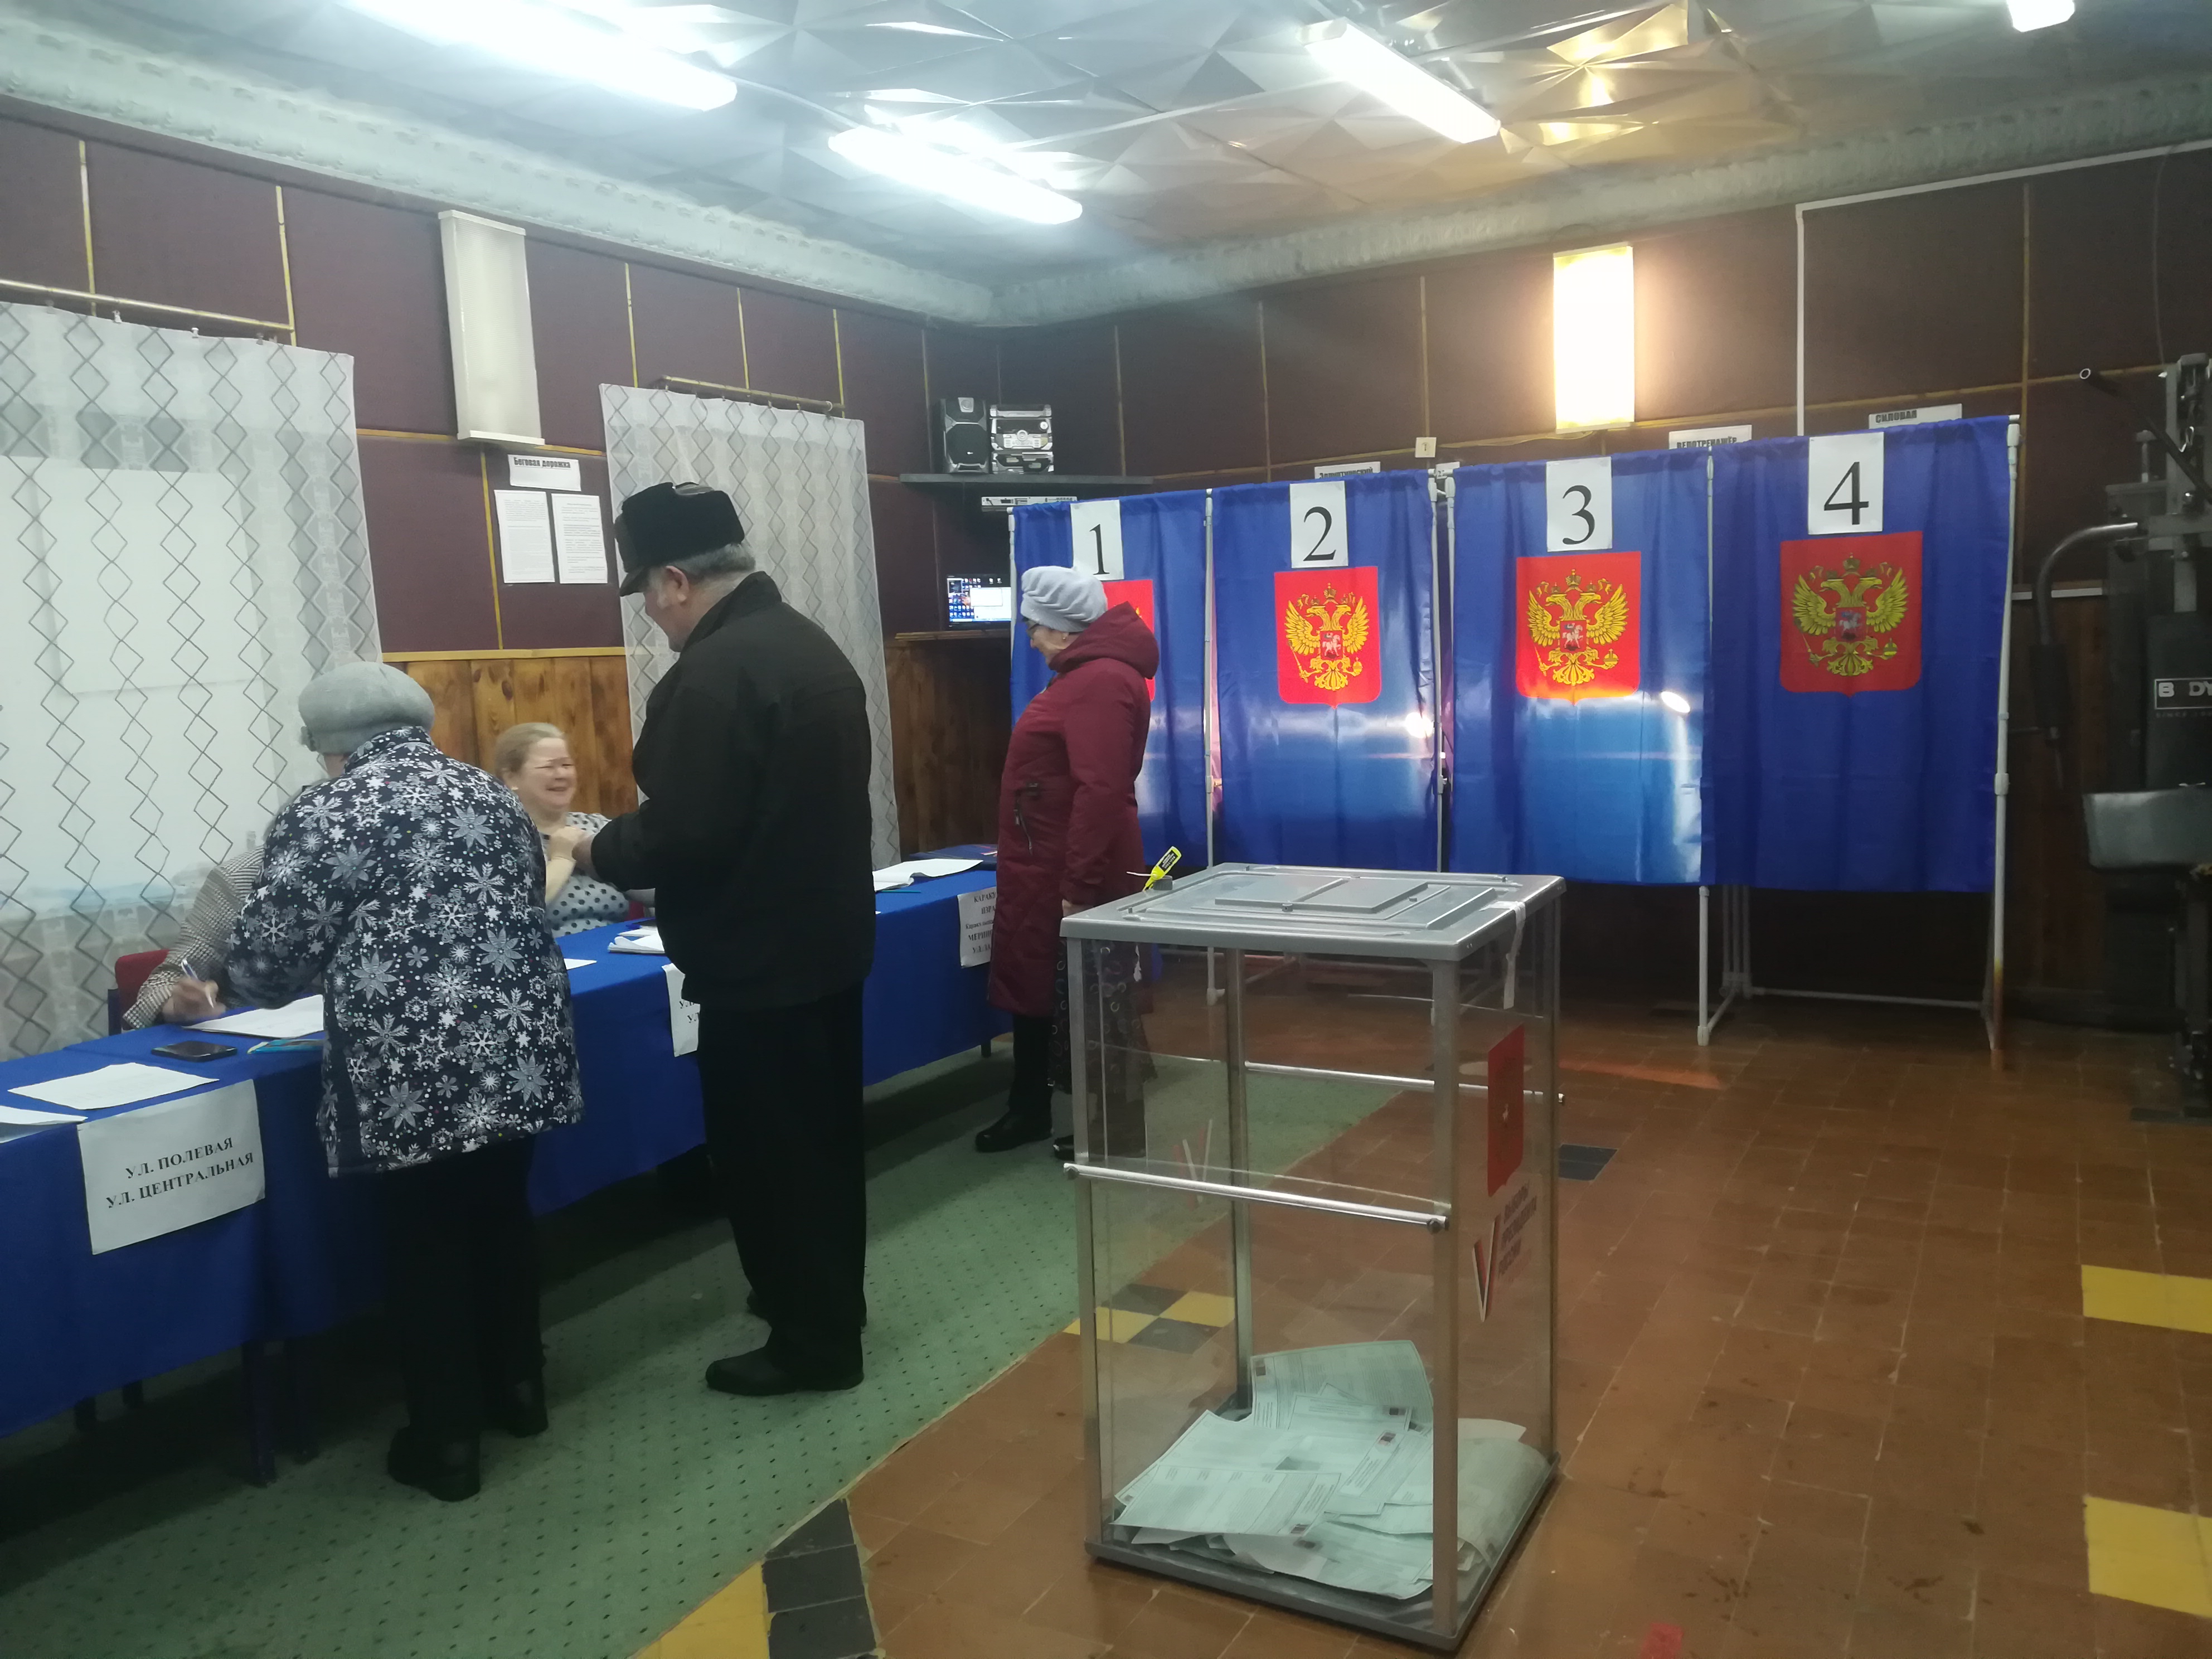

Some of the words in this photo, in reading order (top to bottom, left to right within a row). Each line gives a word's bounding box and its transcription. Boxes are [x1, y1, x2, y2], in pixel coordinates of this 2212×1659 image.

[1875, 409, 1917, 424] СИЛОВАЯ
[513, 457, 541, 467] Беговая
[542, 460, 571, 469] дорожка
[1562, 484, 1595, 545] 3
[1824, 462, 1869, 525] 4
[1089, 523, 1110, 575] 1
[1303, 506, 1337, 561] 2
[106, 1192, 135, 1209] УЛ.
[139, 1152, 254, 1199] ЦЕНТРАЛЬНАЯ
[125, 1163, 154, 1179] УЛ.
[158, 1137, 234, 1170] ПОЛЕВАЯ
